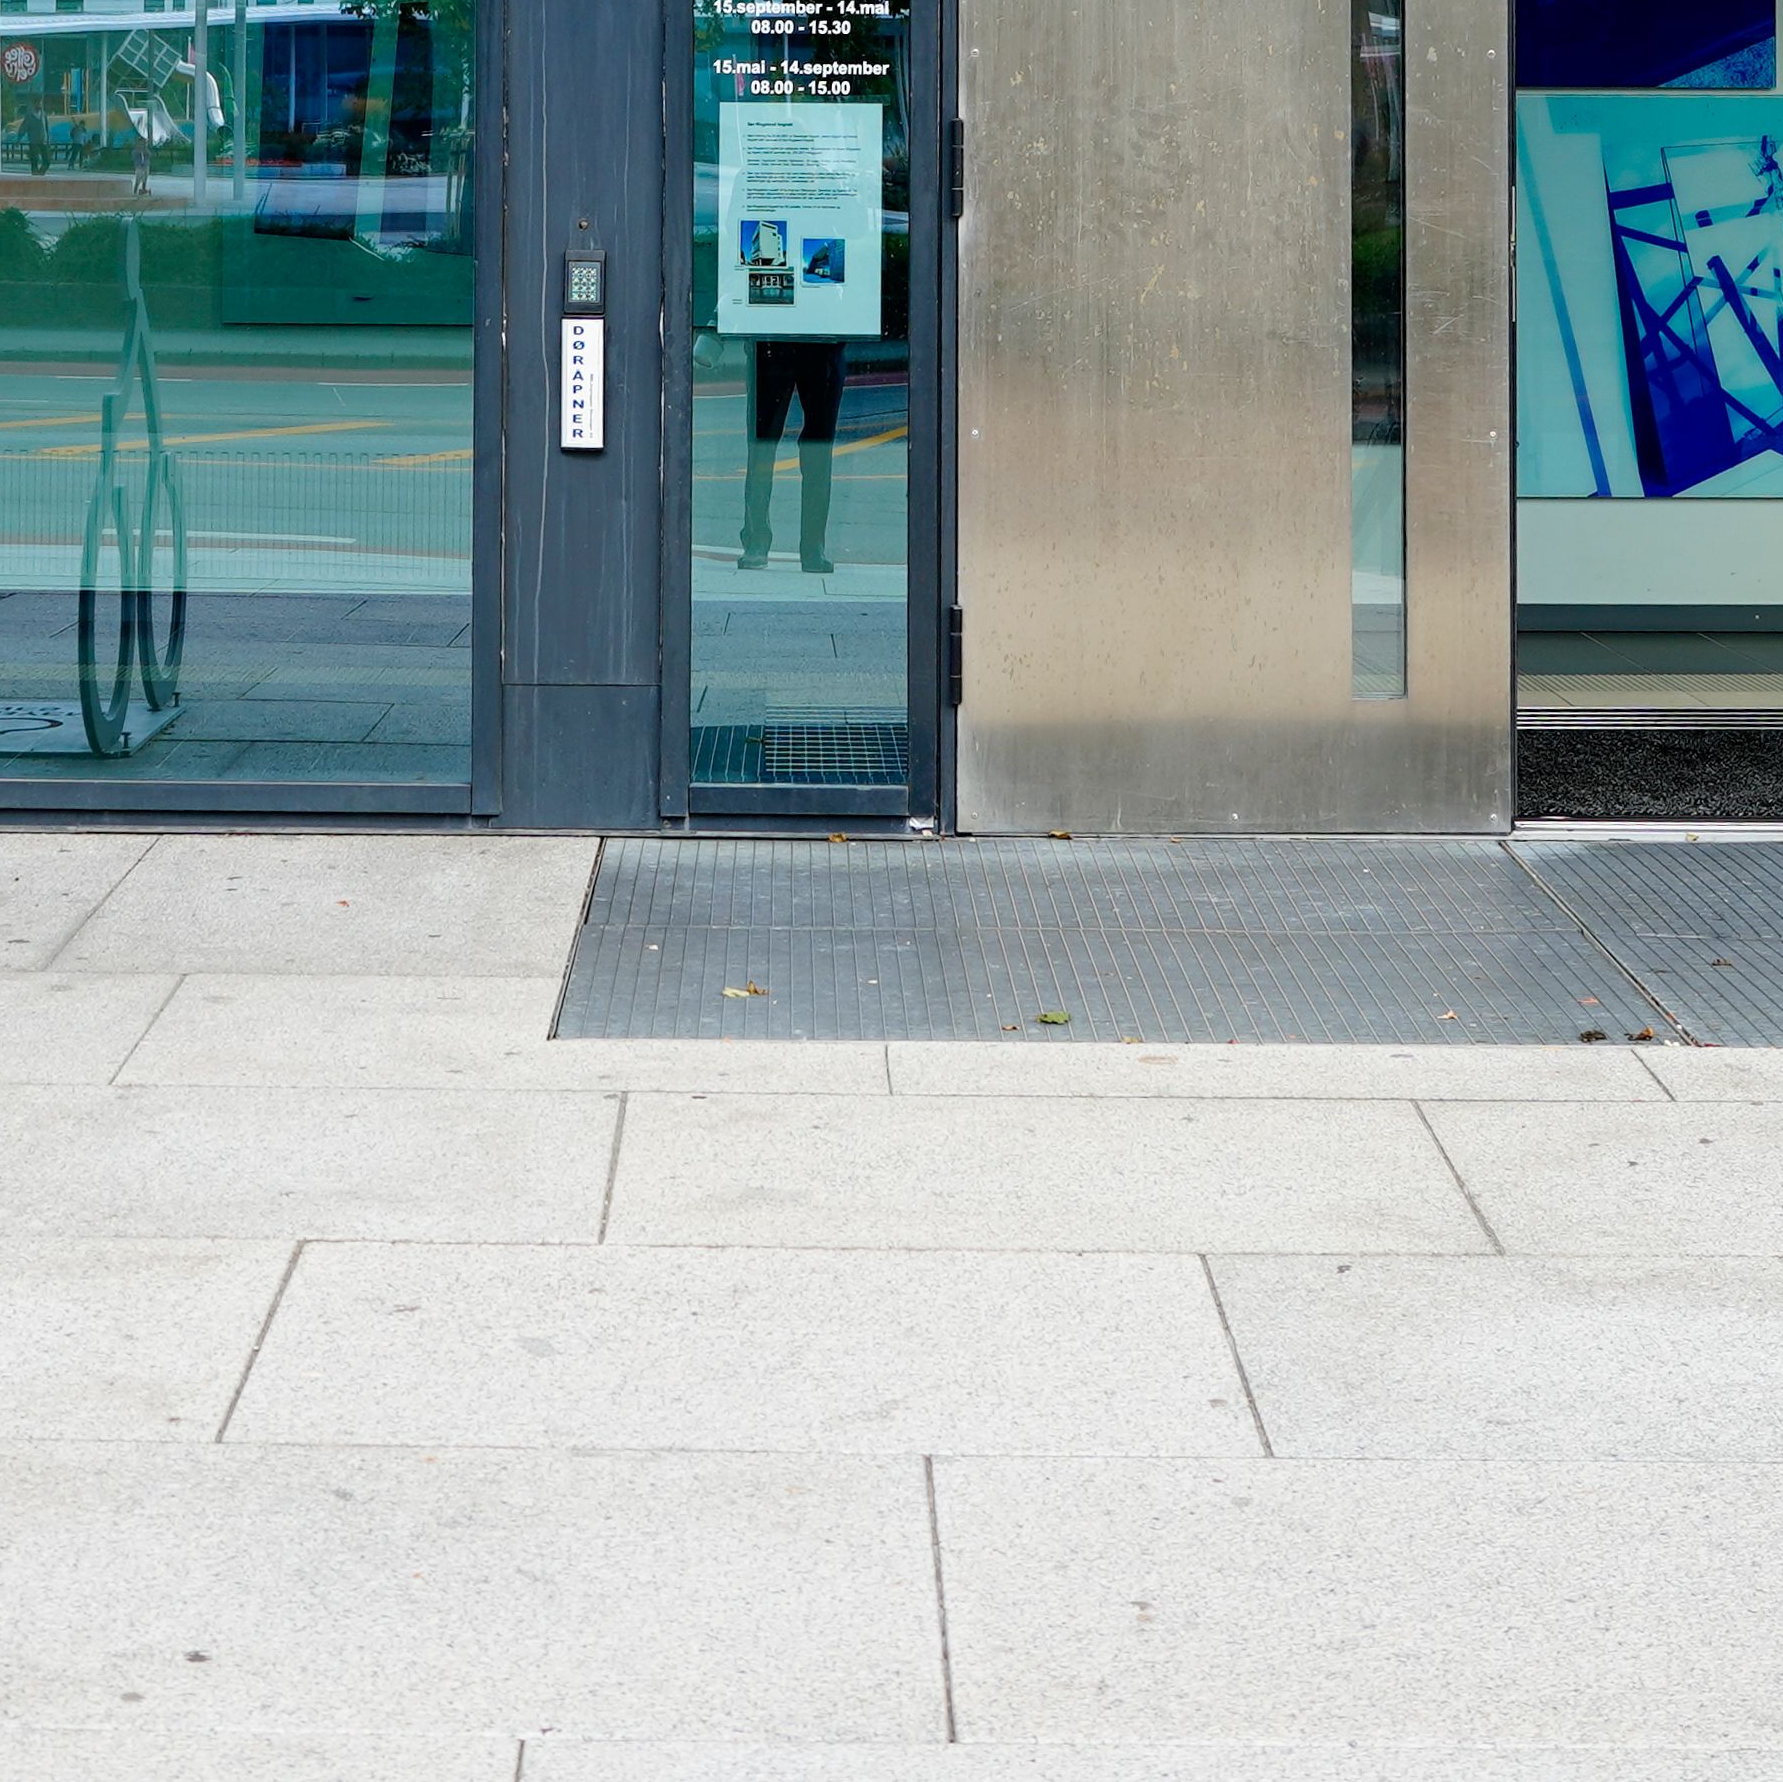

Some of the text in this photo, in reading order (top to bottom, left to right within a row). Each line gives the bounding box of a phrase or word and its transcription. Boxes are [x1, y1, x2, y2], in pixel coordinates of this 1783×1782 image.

[713, 0, 823, 16] 15.september
[837, 0, 890, 15] 14.mai
[751, 20, 794, 35] 08.00
[809, 20, 851, 35] 15.30
[713, 59, 766, 75] 15.mai
[780, 60, 890, 77] 14.september
[750, 80, 794, 95] 08.00
[808, 80, 851, 95] 15.00
[572, 326, 585, 439] DØRAPNER
